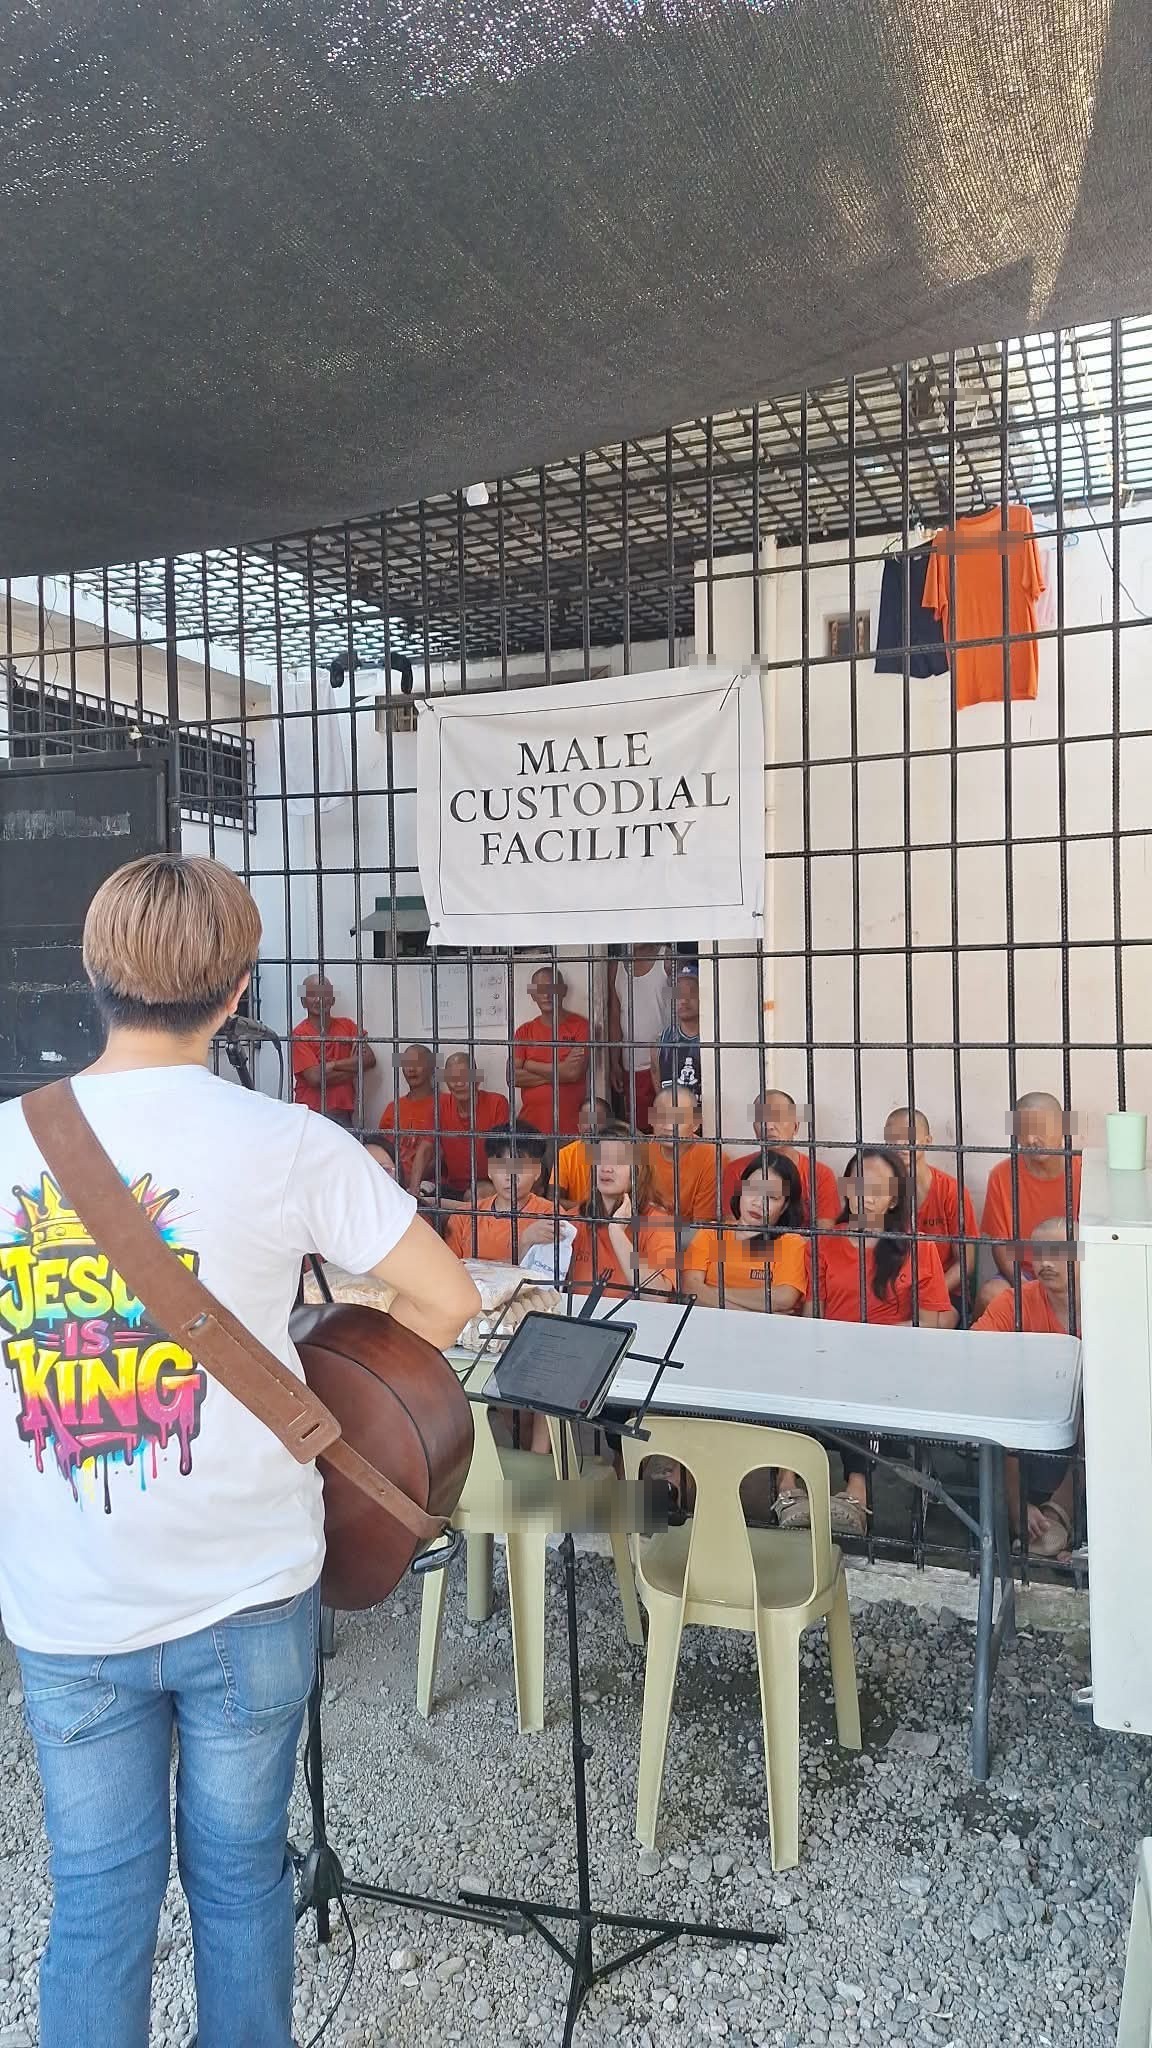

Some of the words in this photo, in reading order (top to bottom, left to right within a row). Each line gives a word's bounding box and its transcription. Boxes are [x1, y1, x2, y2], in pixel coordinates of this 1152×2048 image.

[516, 731, 651, 776] MALE
[449, 772, 731, 823] CUSTODIAL
[480, 820, 697, 866] FACILITY
[0, 1246, 195, 1331] JESU
[64, 1320, 111, 1356] IS
[9, 1338, 200, 1444] KING
